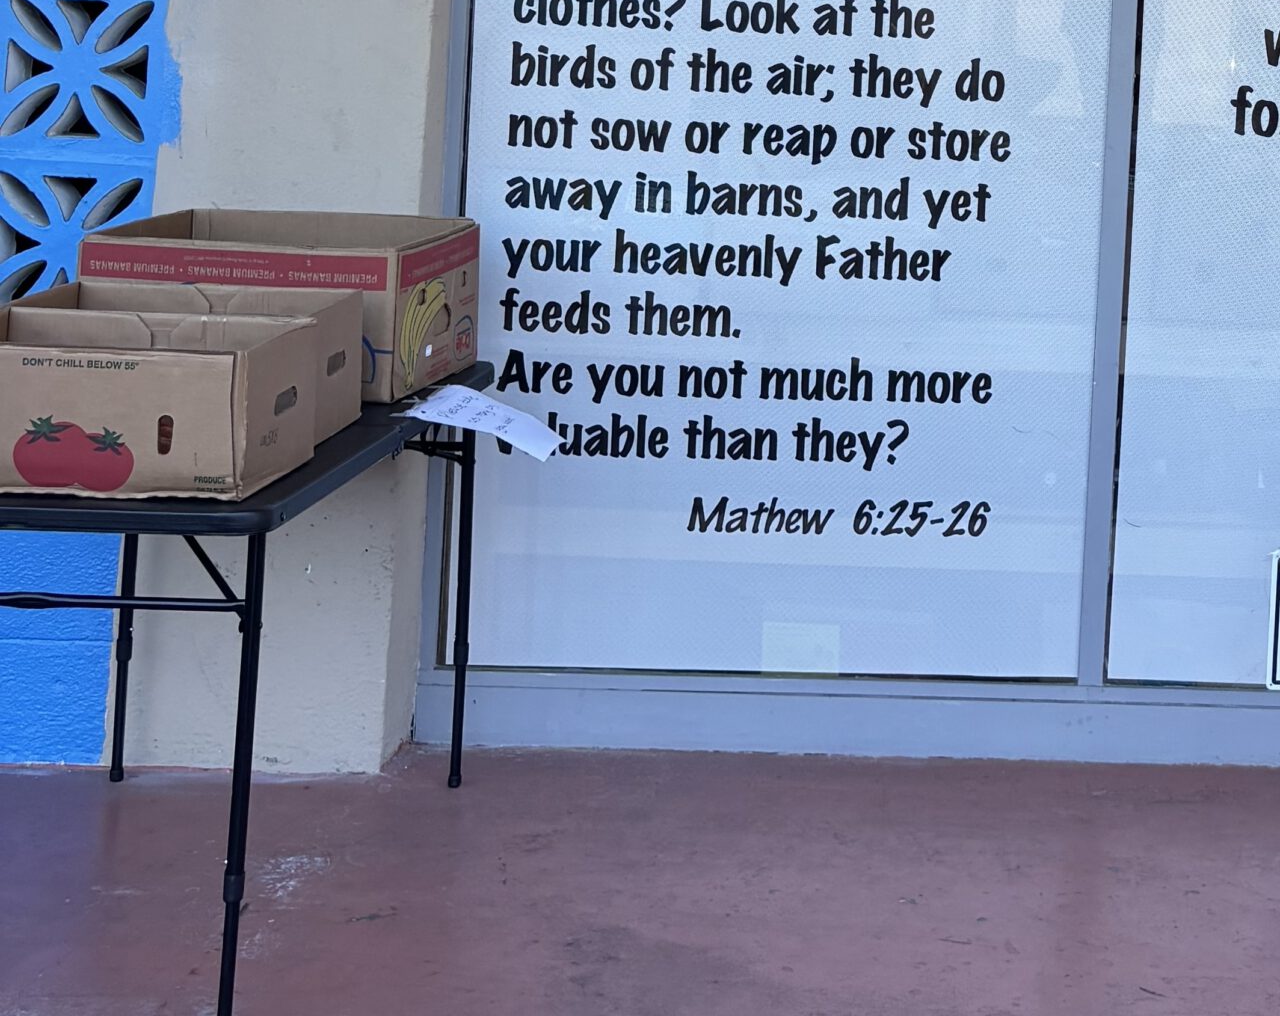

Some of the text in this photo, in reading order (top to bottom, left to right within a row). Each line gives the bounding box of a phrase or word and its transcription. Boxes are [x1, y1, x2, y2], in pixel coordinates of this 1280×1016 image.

[511, 41, 1005, 108] birds of the air; they do
[508, 110, 1011, 165] not sow or reap or store
[505, 171, 991, 229] away in barns, and yet
[502, 238, 601, 278] your
[614, 228, 802, 286] heavenly
[816, 235, 951, 282] Father
[500, 288, 610, 334] feeds
[625, 291, 741, 338] them.
[22, 357, 54, 367] DON'T
[55, 359, 84, 368] CHILL
[87, 360, 122, 370] BELOW
[496, 349, 573, 394] Are
[587, 364, 665, 404] you
[678, 360, 747, 399] not
[759, 357, 873, 401] much
[887, 370, 992, 404] more
[496, 412, 669, 458] luable
[683, 415, 777, 461] than
[792, 417, 909, 471] they?
[194, 476, 226, 485] PRODUCE
[687, 496, 991, 537] Mathew 6:25-26
